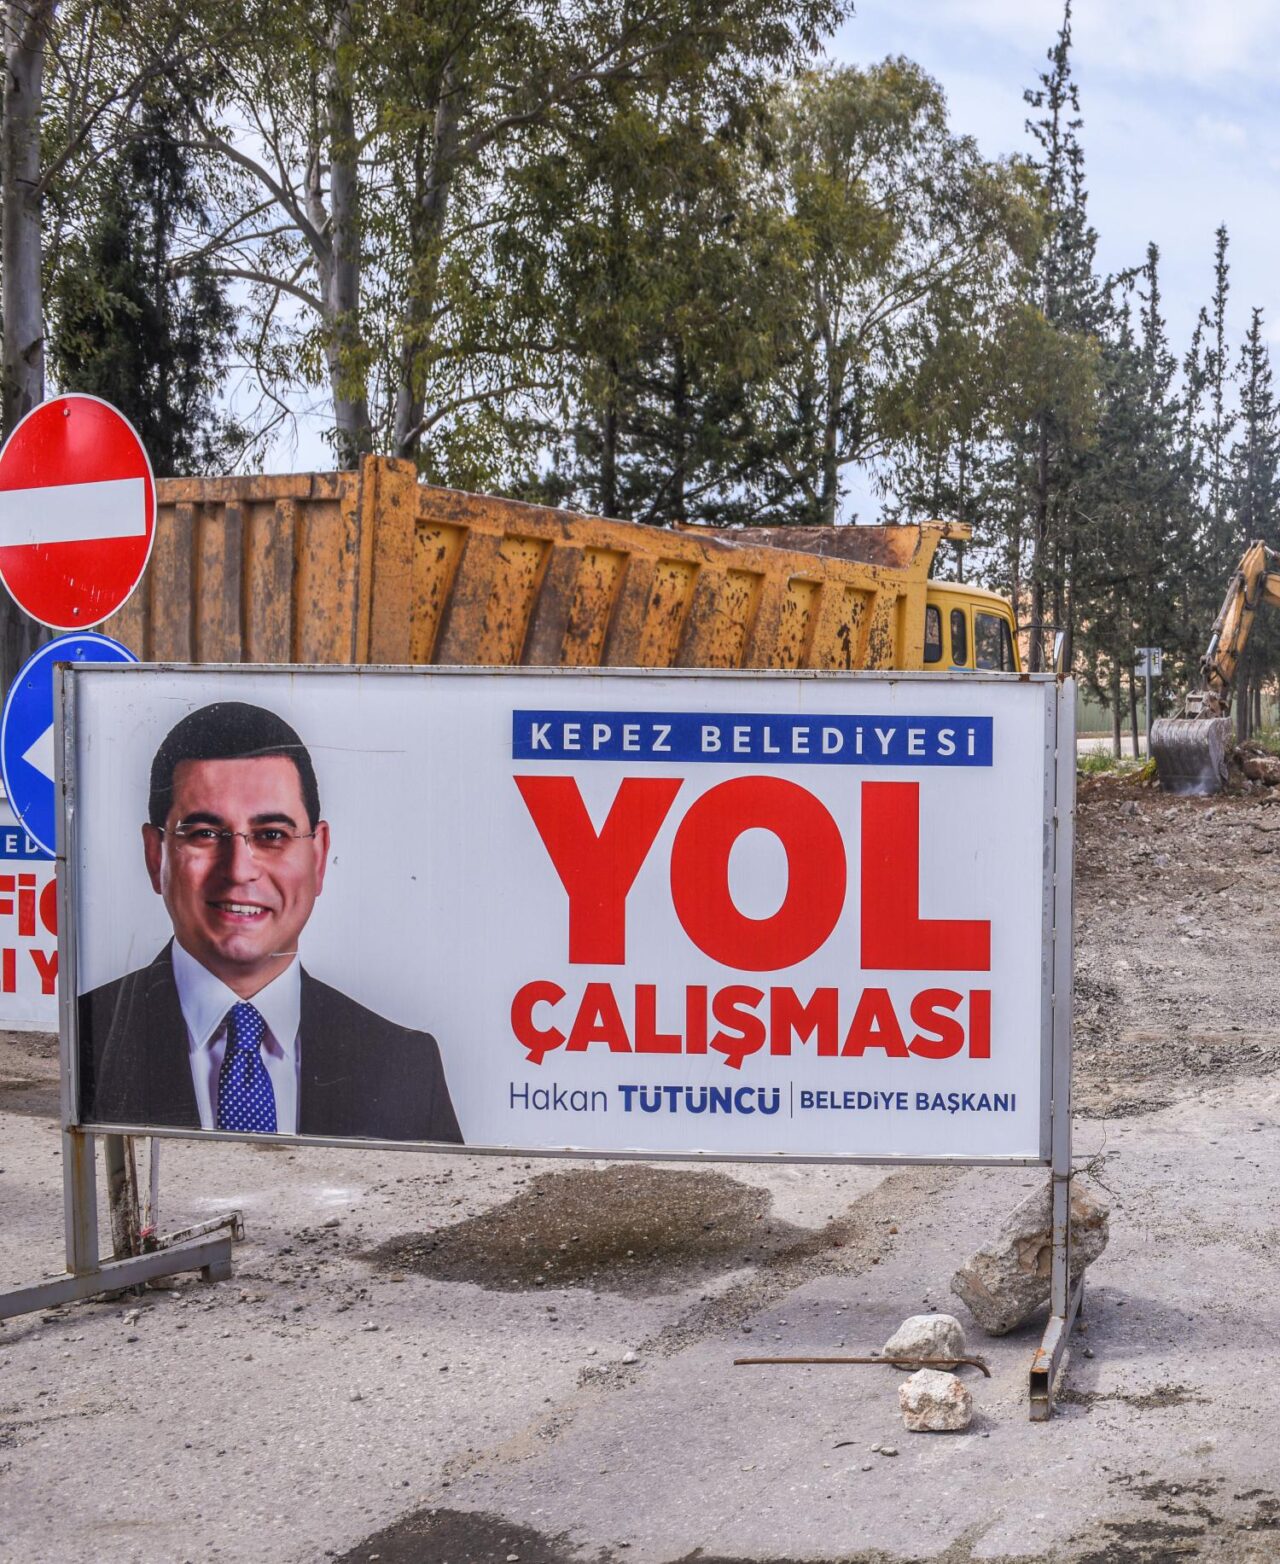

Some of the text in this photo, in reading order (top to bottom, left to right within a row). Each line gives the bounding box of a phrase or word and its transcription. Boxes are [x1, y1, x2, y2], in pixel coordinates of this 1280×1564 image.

[531, 722, 975, 757] KEPEZ BELEDİYESİ
[512, 774, 991, 972] YOL
[511, 980, 991, 1070] ÇALIŞMASI
[510, 1082, 1016, 1115] Hakan TÜTÜNCÜ BELEDİYE BAŞKANI
